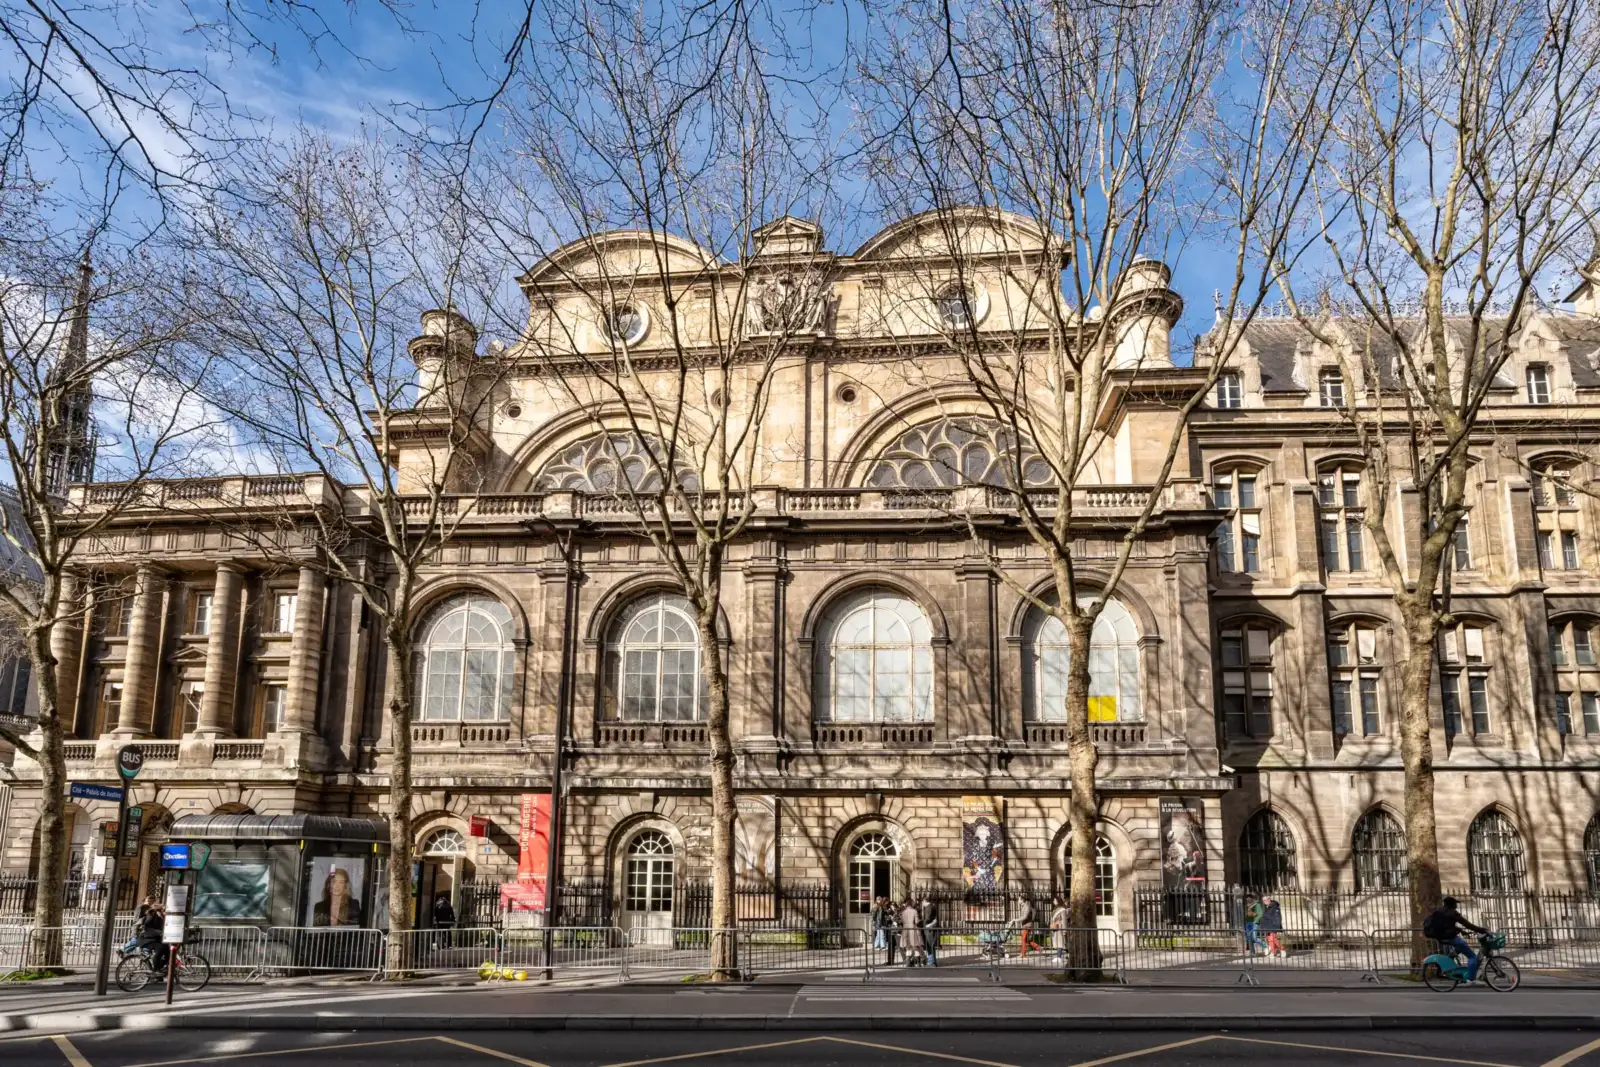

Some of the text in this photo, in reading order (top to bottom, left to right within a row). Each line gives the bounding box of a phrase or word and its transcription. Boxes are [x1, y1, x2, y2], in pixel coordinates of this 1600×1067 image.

[122, 752, 140, 764] BUS
[521, 795, 532, 852] CONCIERGERIE
[105, 840, 116, 848] 96
